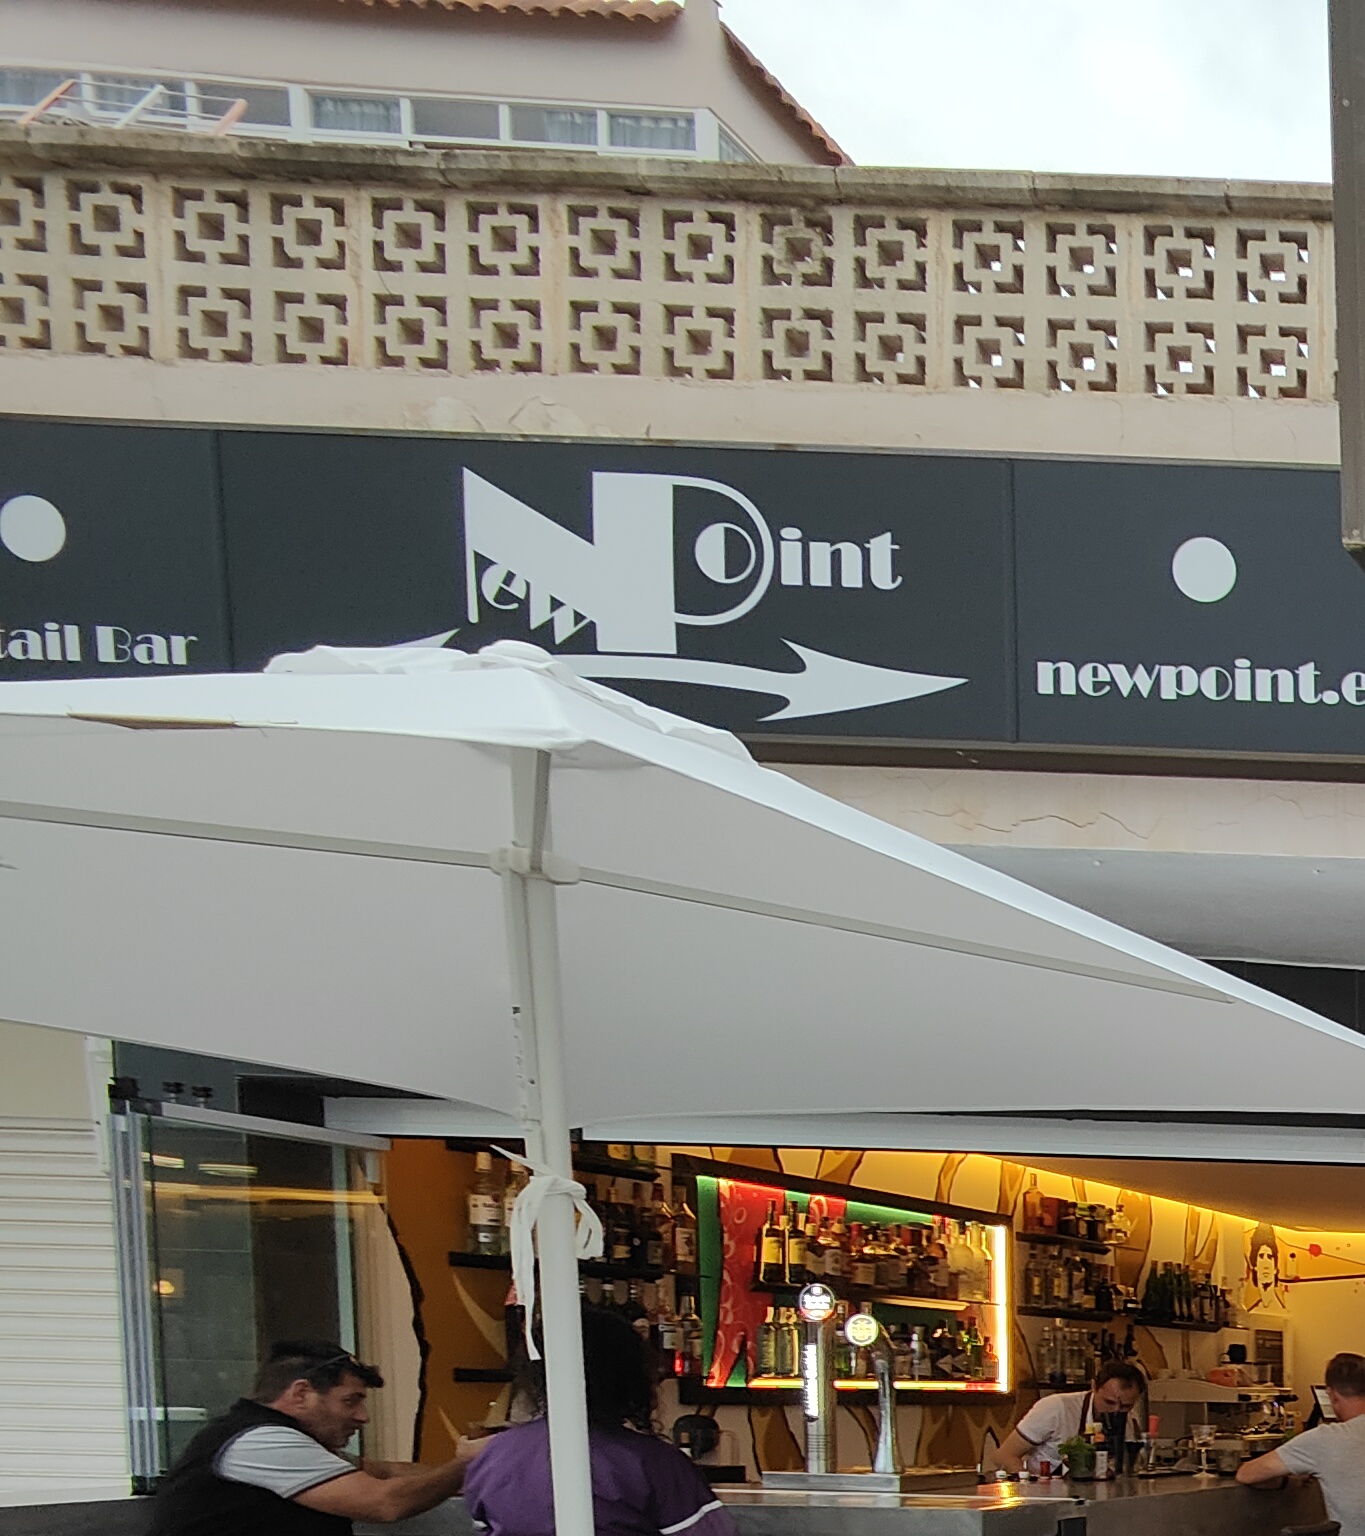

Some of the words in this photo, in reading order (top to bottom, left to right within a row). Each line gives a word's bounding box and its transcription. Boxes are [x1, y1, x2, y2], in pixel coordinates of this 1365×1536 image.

[590, 471, 904, 655] Point
[0, 622, 82, 662] ail
[95, 625, 199, 666] Bar
